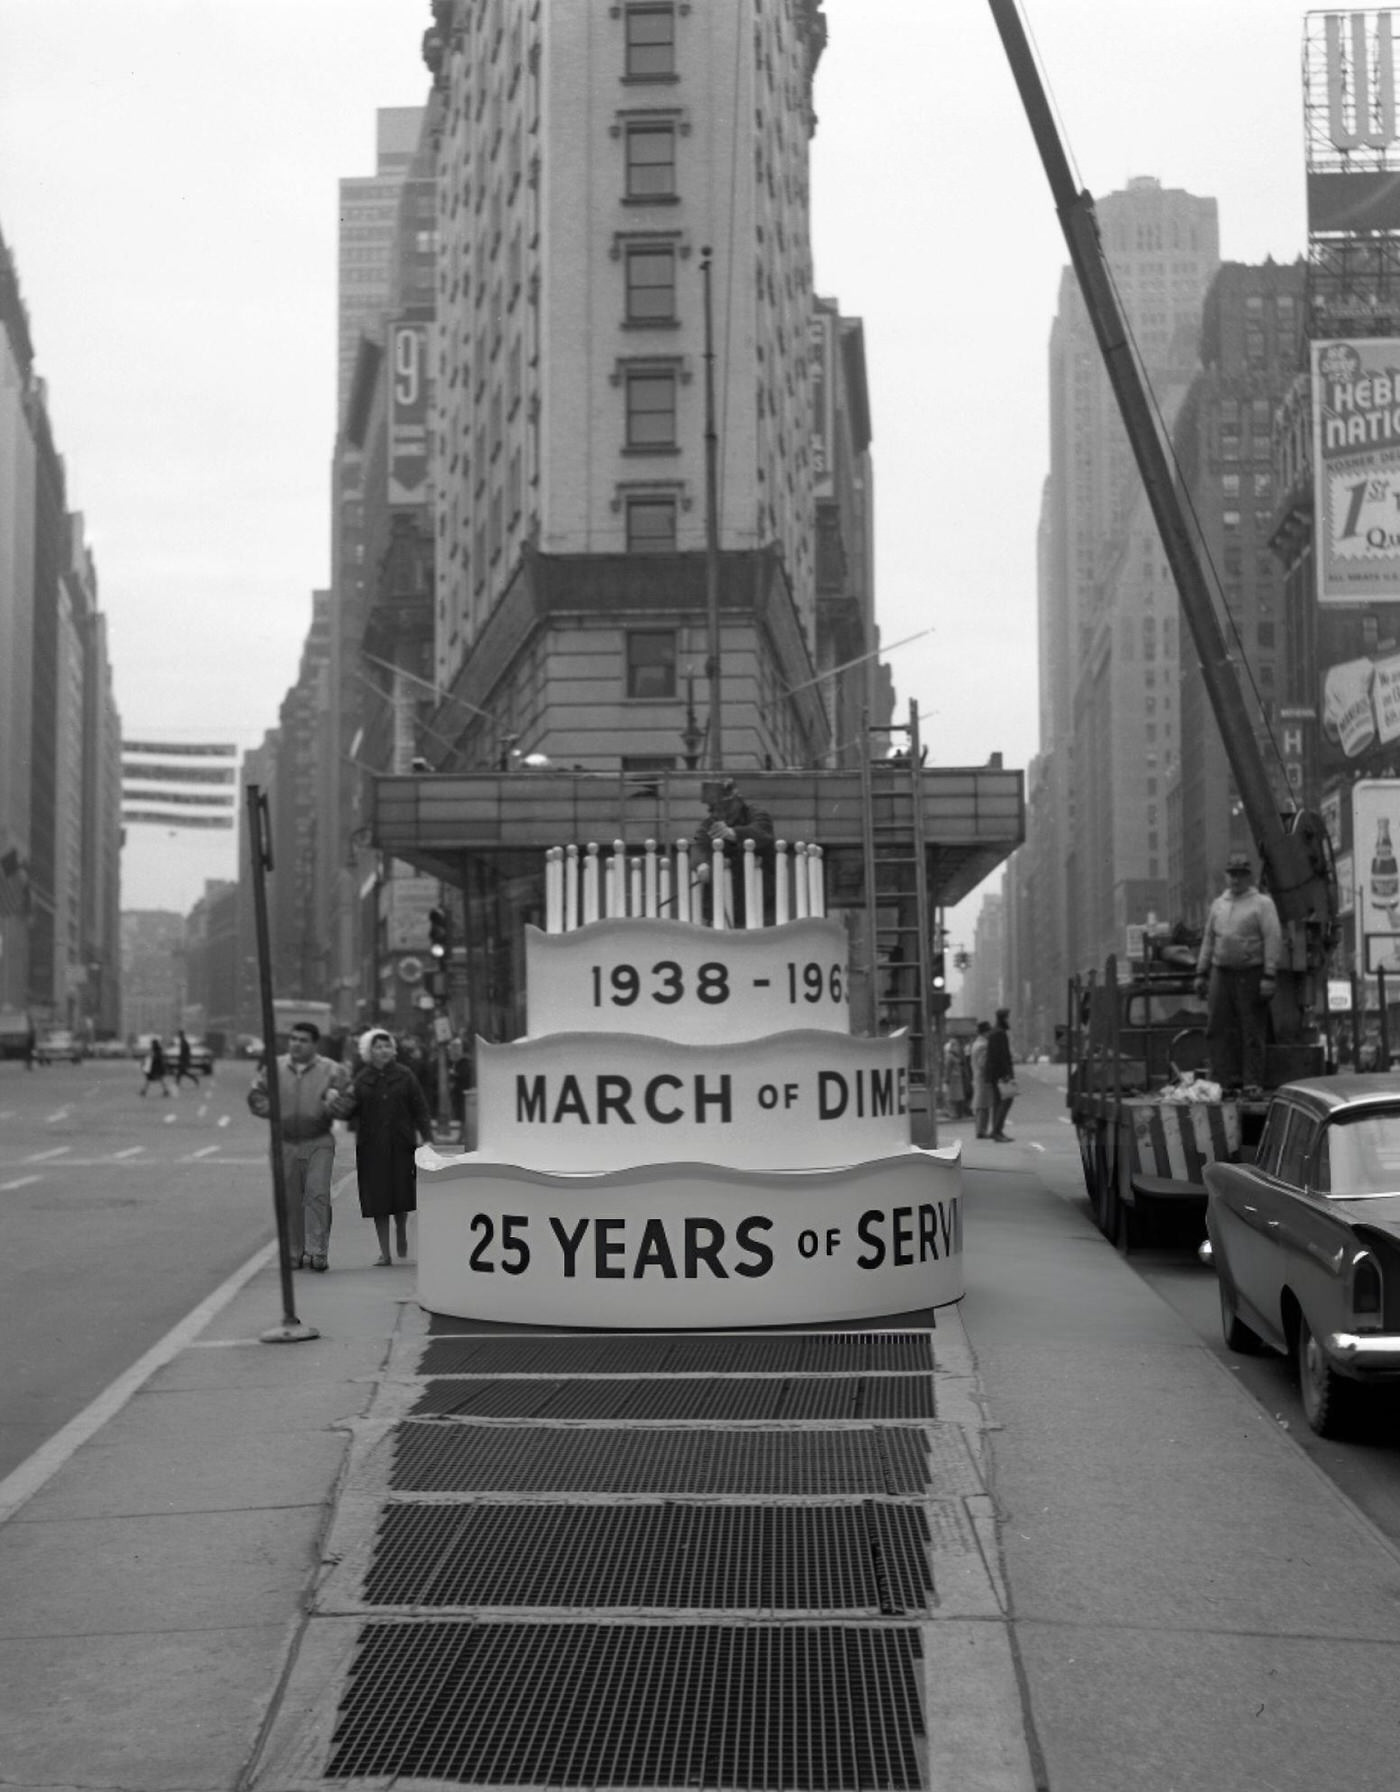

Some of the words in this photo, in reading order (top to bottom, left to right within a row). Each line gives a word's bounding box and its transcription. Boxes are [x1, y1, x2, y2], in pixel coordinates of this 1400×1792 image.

[592, 960, 730, 1008] 1938
[516, 1073, 733, 1125] MARCH
[758, 1083, 799, 1110] OF
[817, 1066, 907, 1121] DIME
[469, 1212, 531, 1276] 25
[549, 1215, 774, 1279] YEARS
[798, 1227, 841, 1259] OF
